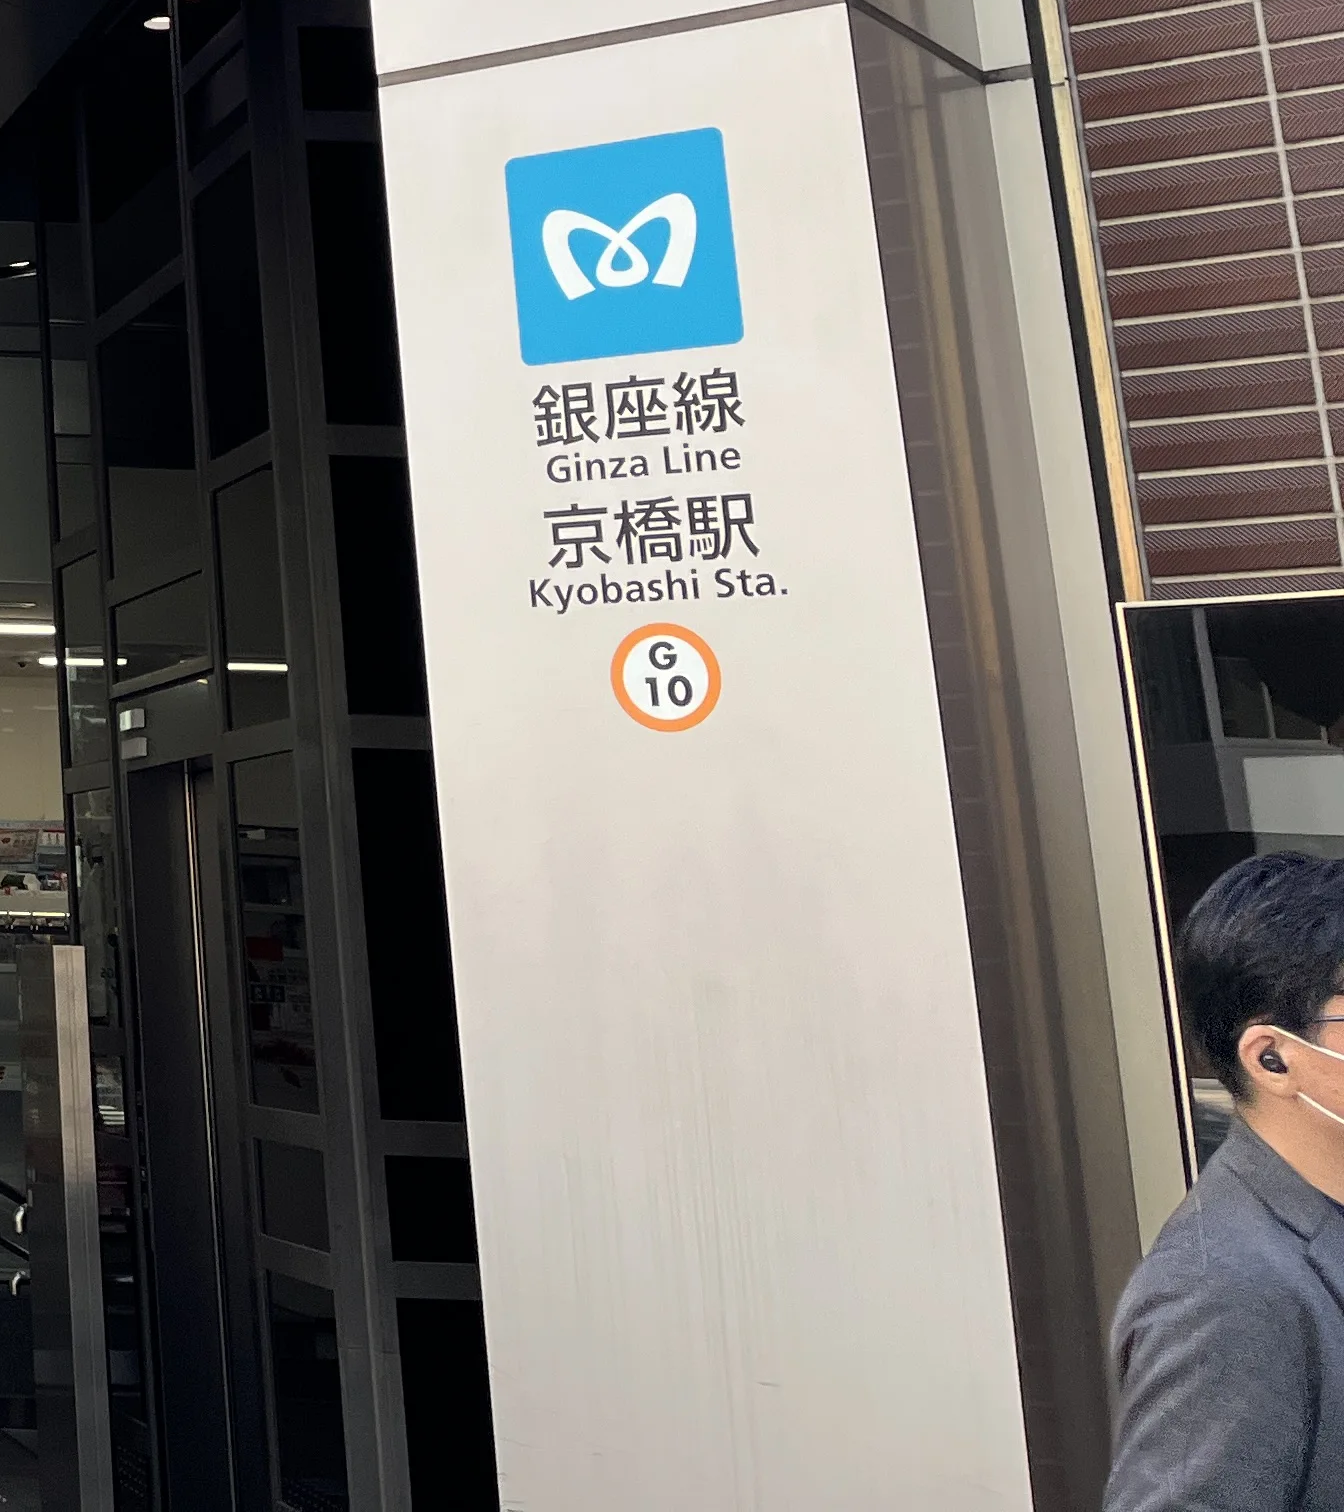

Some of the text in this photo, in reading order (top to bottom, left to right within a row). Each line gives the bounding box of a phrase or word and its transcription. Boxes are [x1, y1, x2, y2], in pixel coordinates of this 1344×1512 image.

[531, 366, 746, 448] 銀座線
[545, 443, 742, 484] Ginza Line
[543, 491, 761, 570] 京橋駅
[529, 567, 789, 615] Kyobashi Sta.
[648, 640, 678, 671] G
[644, 674, 694, 708] 10
